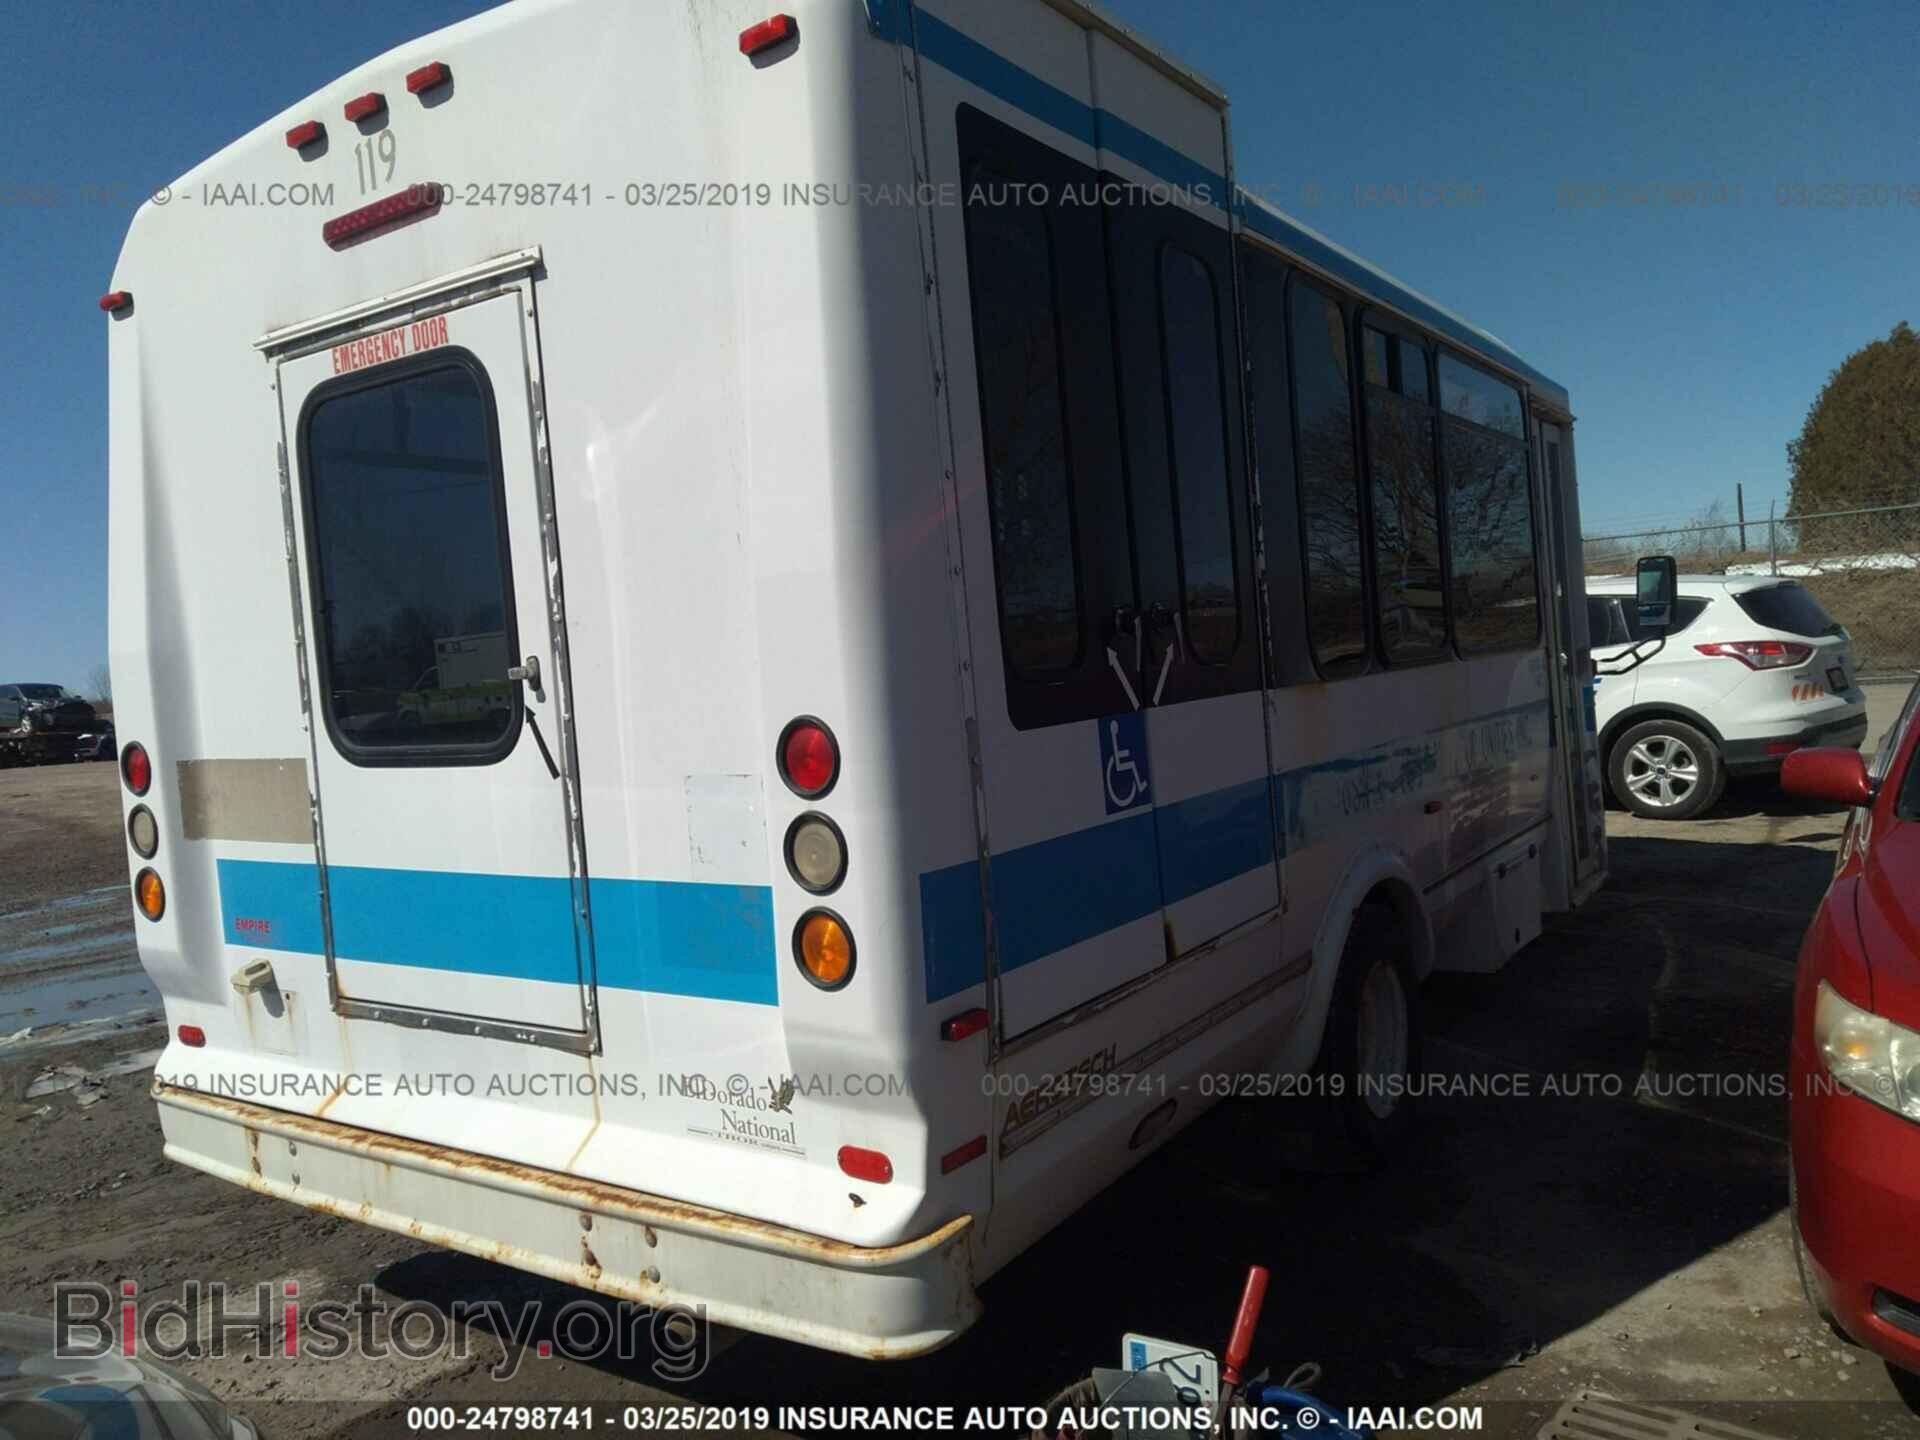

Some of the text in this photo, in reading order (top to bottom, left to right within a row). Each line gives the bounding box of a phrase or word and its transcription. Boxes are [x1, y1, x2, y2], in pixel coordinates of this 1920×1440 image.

[354, 128, 396, 195] 119
[332, 315, 449, 374] EMERGENCY DOOR
[234, 918, 272, 934] EMPIRE
[720, 1108, 797, 1145] National
